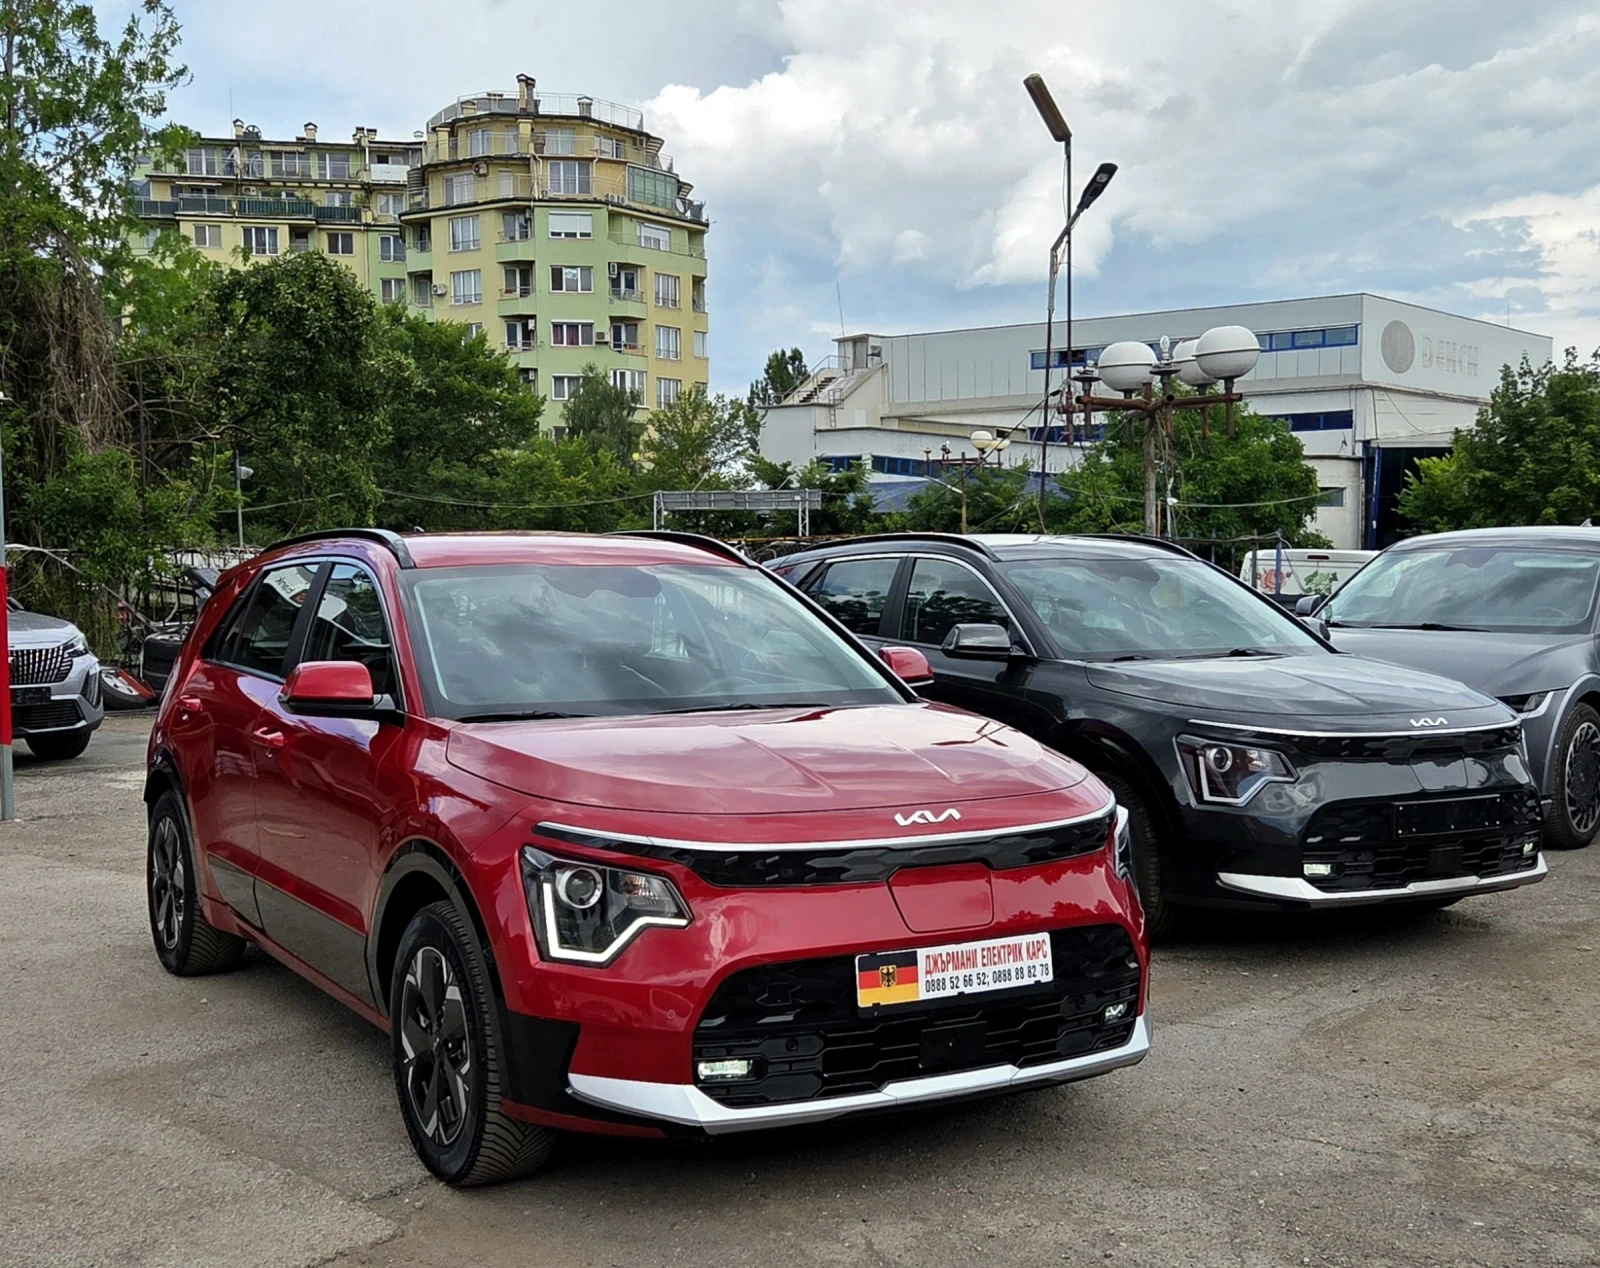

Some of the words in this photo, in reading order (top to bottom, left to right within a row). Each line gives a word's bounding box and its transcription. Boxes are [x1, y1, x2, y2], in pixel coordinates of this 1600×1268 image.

[1410, 717, 1448, 727] KIA
[894, 808, 961, 826] KIA
[925, 948, 978, 978] ДЖЪРМАНИ
[981, 942, 1024, 967] ЕЛЕКТРИК
[1025, 939, 1048, 961] КАРС
[925, 978, 947, 993] 0888
[949, 975, 960, 990] 52
[963, 974, 974, 988] 66
[992, 968, 1012, 984] 0888
[1014, 966, 1025, 981] 88
[1027, 965, 1037, 979] 82
[1039, 963, 1050, 977] 78
